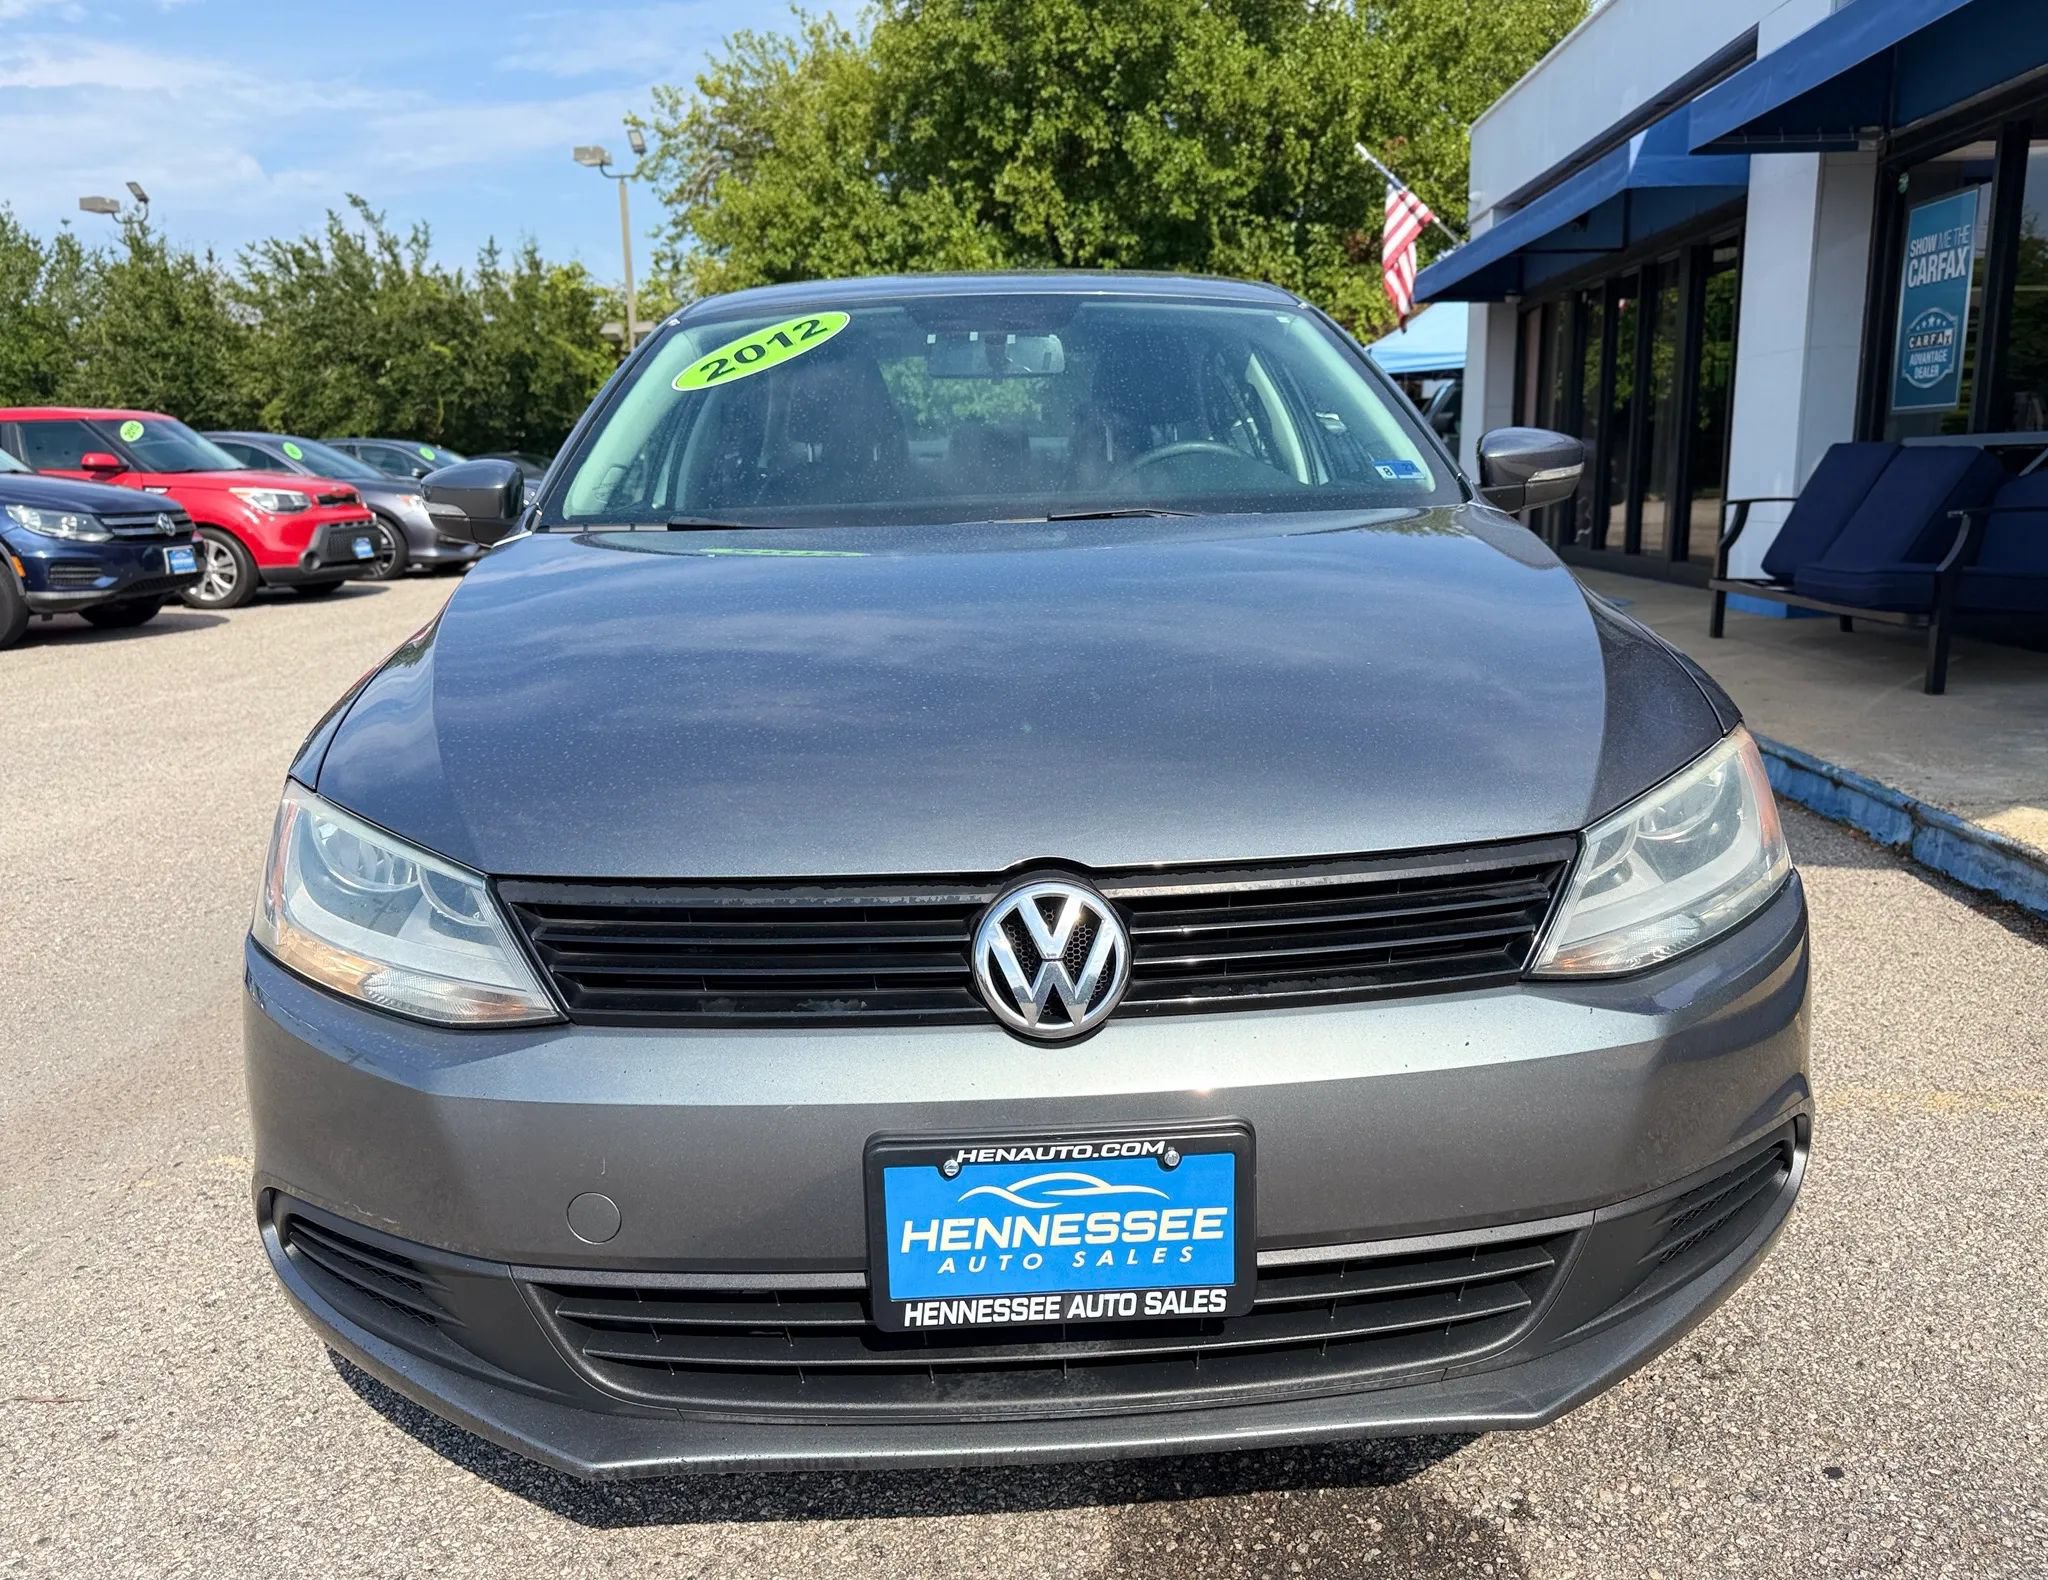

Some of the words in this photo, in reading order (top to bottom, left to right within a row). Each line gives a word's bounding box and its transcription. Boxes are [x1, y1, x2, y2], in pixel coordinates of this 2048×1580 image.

[1910, 233, 1938, 258] SHOW
[1937, 229, 1953, 250] ME
[1953, 224, 1971, 247] THE
[1908, 245, 1970, 288] CARFAX
[699, 319, 828, 382] 2012
[1909, 330, 1953, 348] CARFAX
[1909, 349, 1948, 366] ADVANTAGE
[1914, 364, 1940, 379] DEALER
[1383, 467, 1393, 476] 8
[974, 881, 1130, 1040] VW
[956, 1141, 1165, 1163] HENAUTO.COM
[901, 1207, 1228, 1253] HENNESSEE
[937, 1253, 1043, 1274] AUTO
[1071, 1246, 1194, 1268] SALES
[904, 1295, 1062, 1327] HENNESSEE
[1067, 1292, 1138, 1320] AUTO
[1143, 1288, 1227, 1316] SALES
